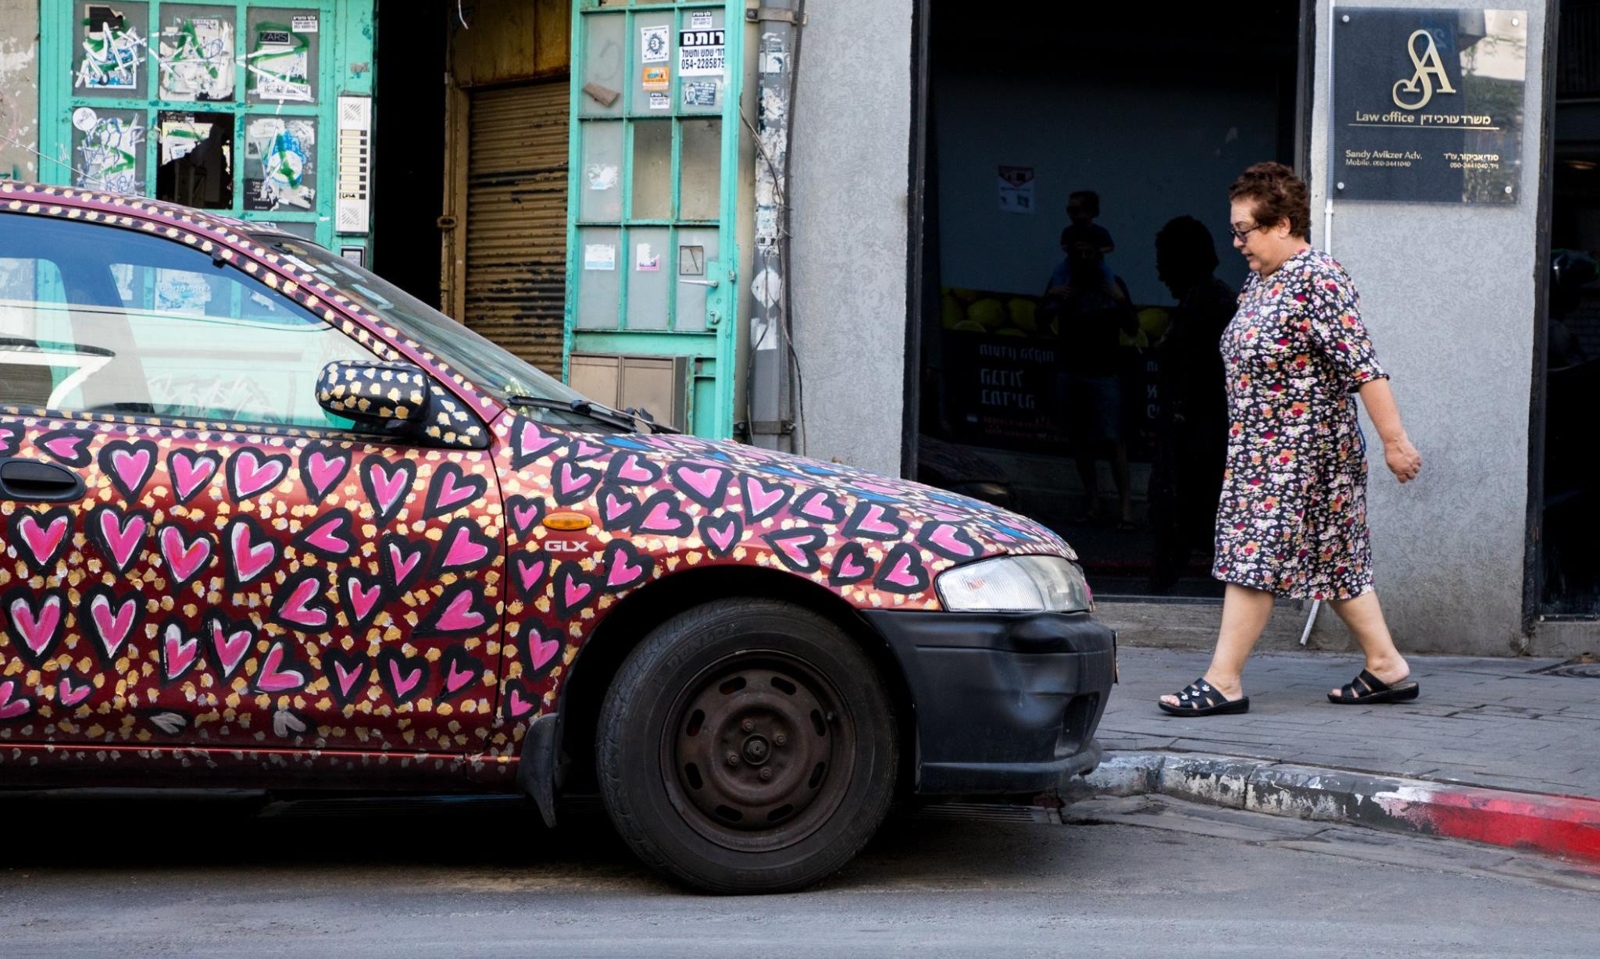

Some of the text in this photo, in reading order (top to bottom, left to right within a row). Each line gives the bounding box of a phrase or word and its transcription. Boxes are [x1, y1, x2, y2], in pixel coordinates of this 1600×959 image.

[683, 31, 725, 46] רותם
[1355, 111, 1415, 123] Law office
[1420, 114, 1491, 125] משרד עורכי דין
[1345, 150, 1371, 160] Sandy
[1404, 151, 1423, 160] Adv.
[544, 540, 589, 553] GLX
